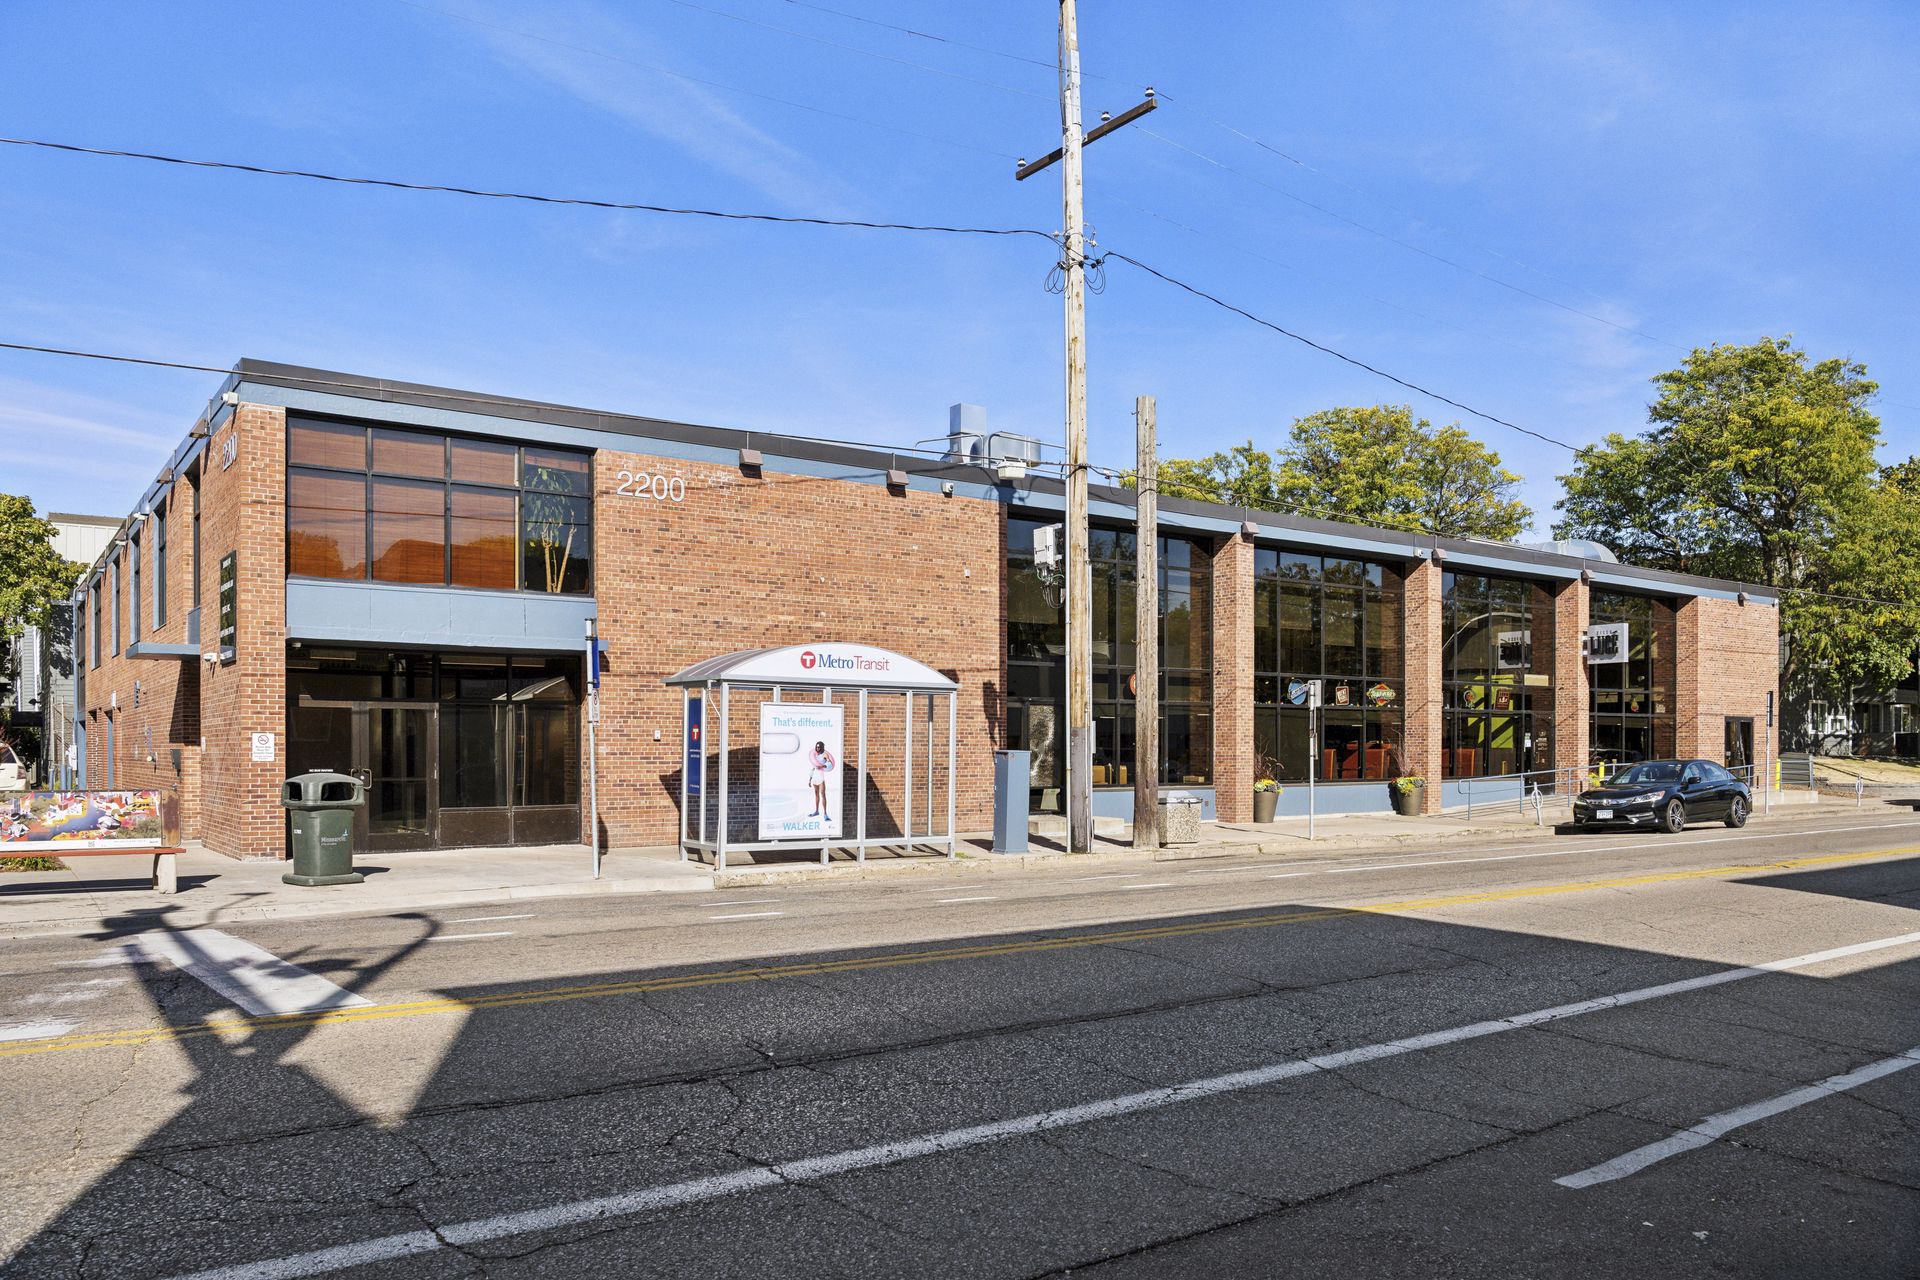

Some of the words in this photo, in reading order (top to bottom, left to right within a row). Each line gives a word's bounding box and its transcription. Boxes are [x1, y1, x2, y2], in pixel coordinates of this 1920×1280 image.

[616, 470, 685, 502] 2200
[772, 716, 797, 727] That's
[798, 717, 833, 728] different.
[783, 821, 821, 831] WALKER
